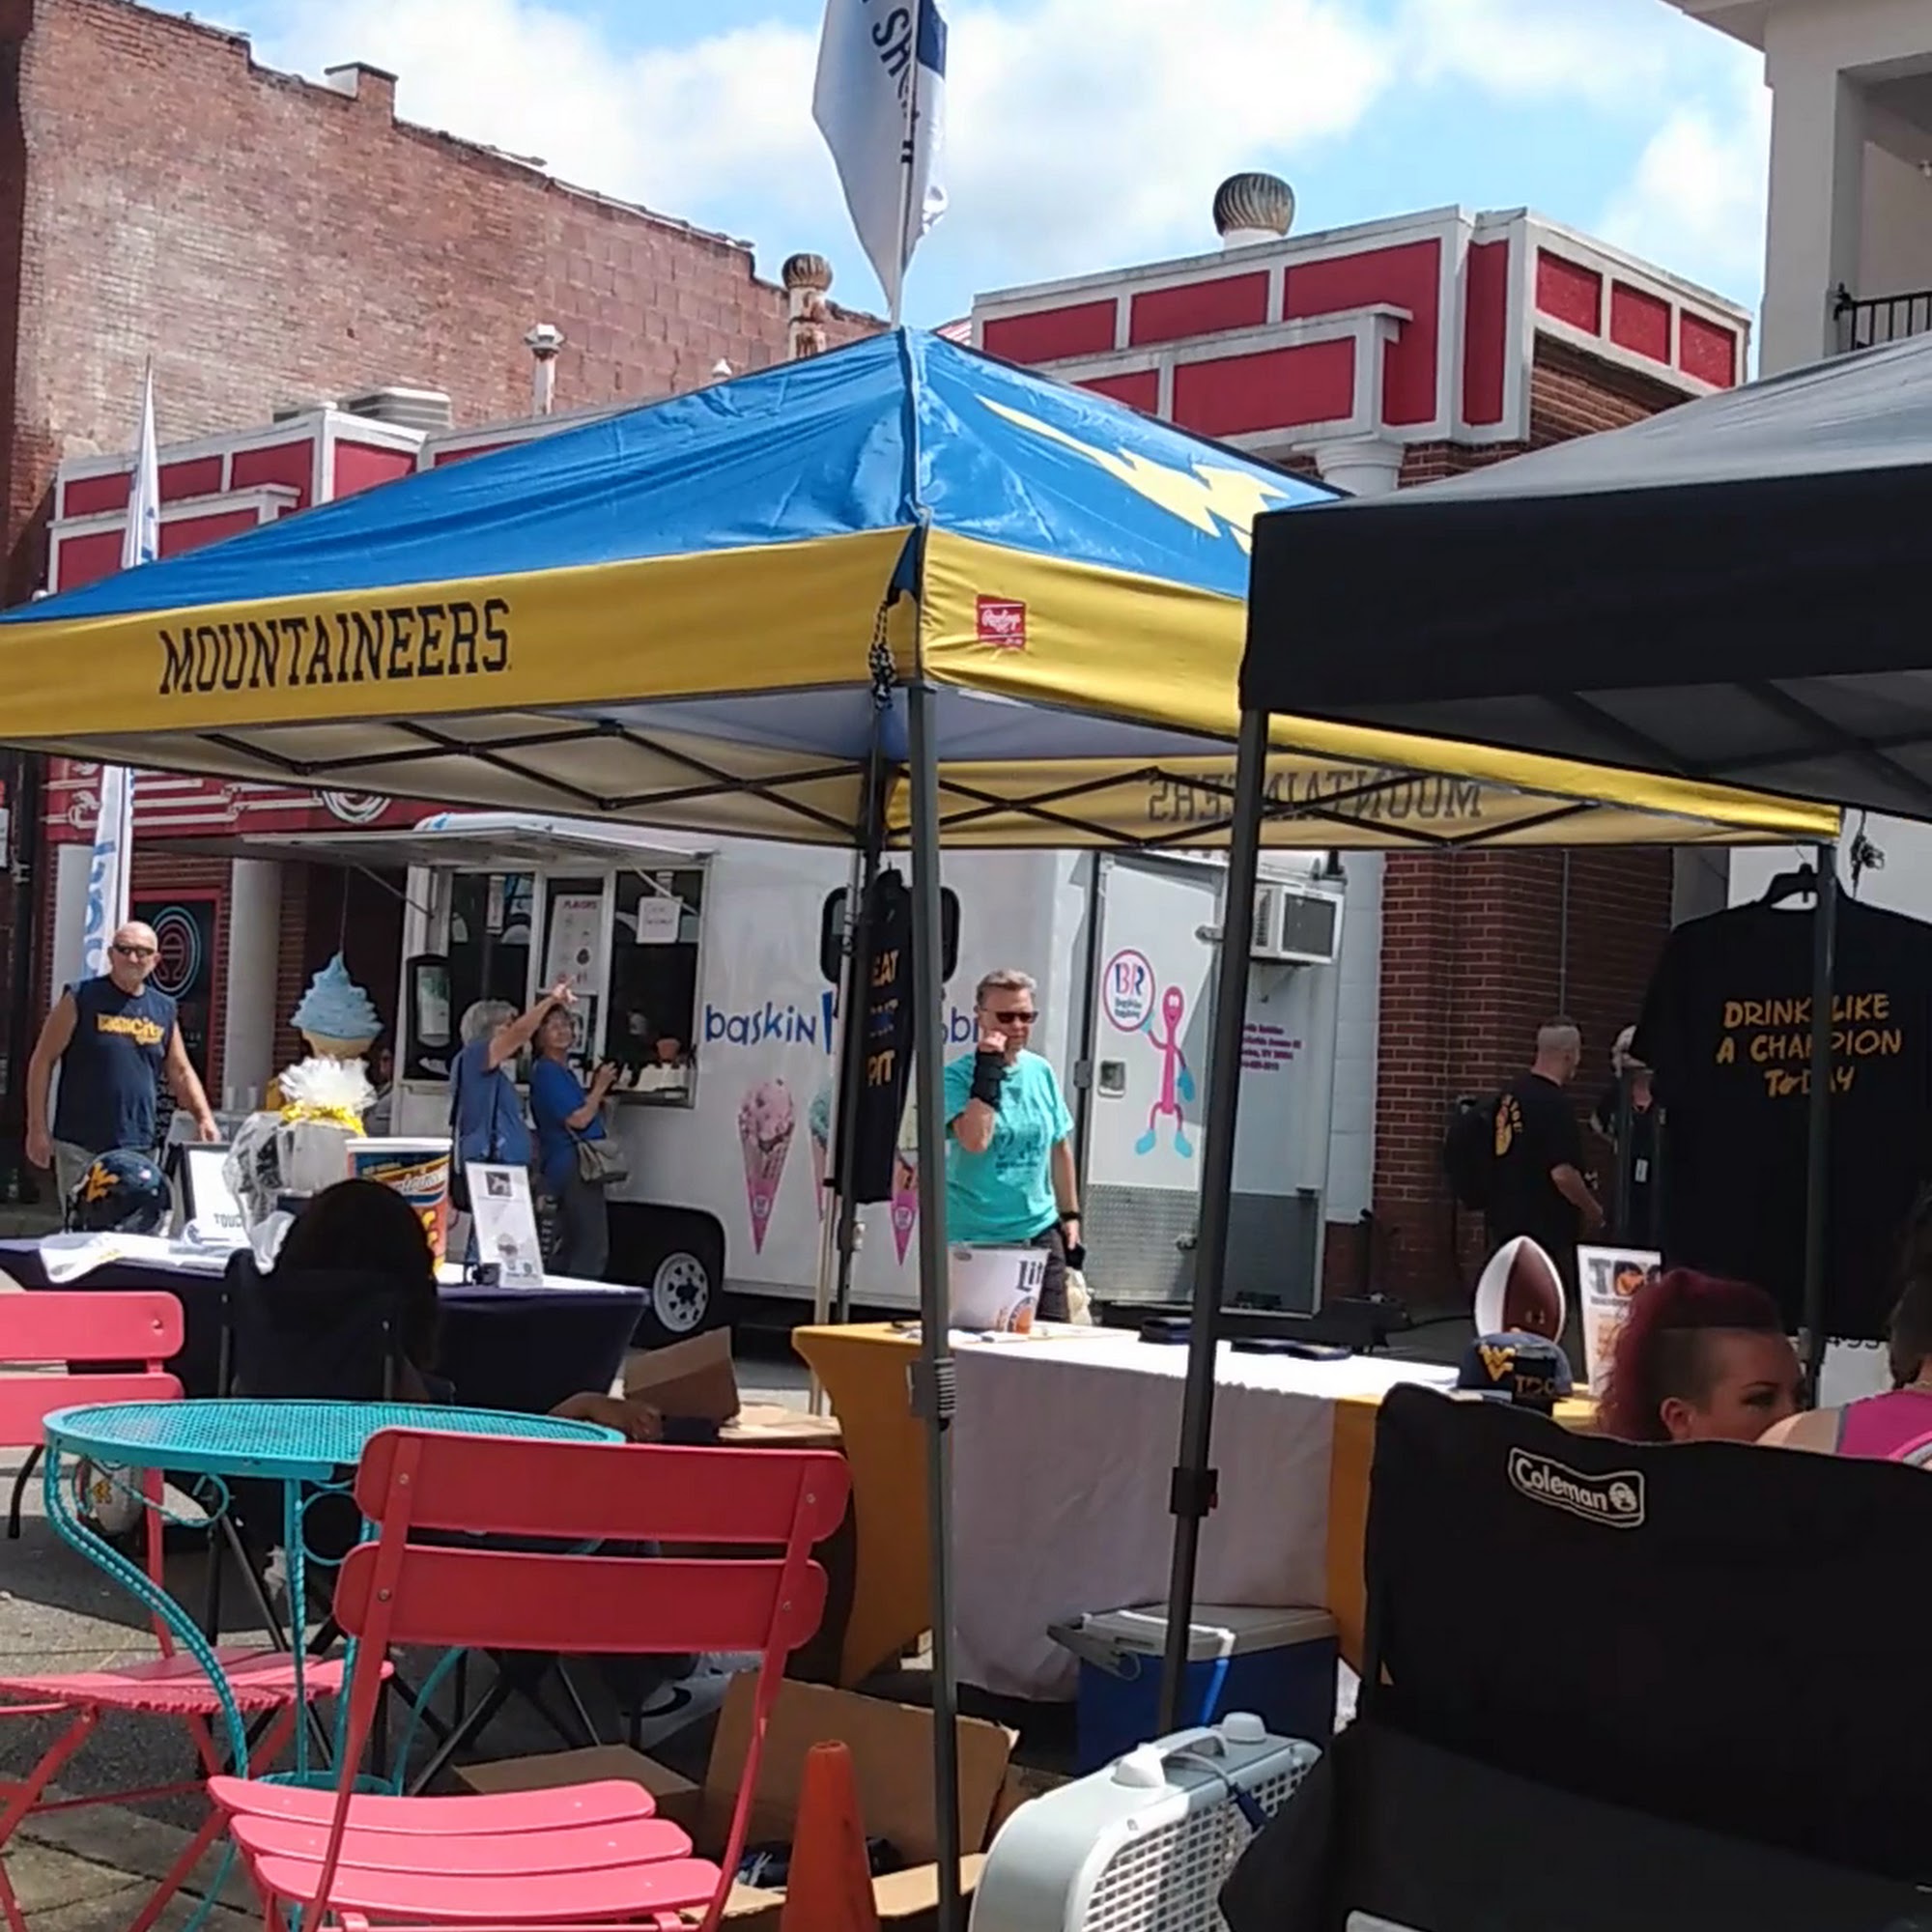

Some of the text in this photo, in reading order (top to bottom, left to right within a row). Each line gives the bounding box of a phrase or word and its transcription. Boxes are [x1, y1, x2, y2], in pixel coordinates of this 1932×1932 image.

[159, 598, 509, 695] MOUNTAINEERS
[1723, 994, 1889, 1029] DRINK LIKE
[1717, 1029, 1902, 1064] A CHAPION
[213, 1212, 242, 1229] TOUC
[1515, 1457, 1608, 1502] Coleman
